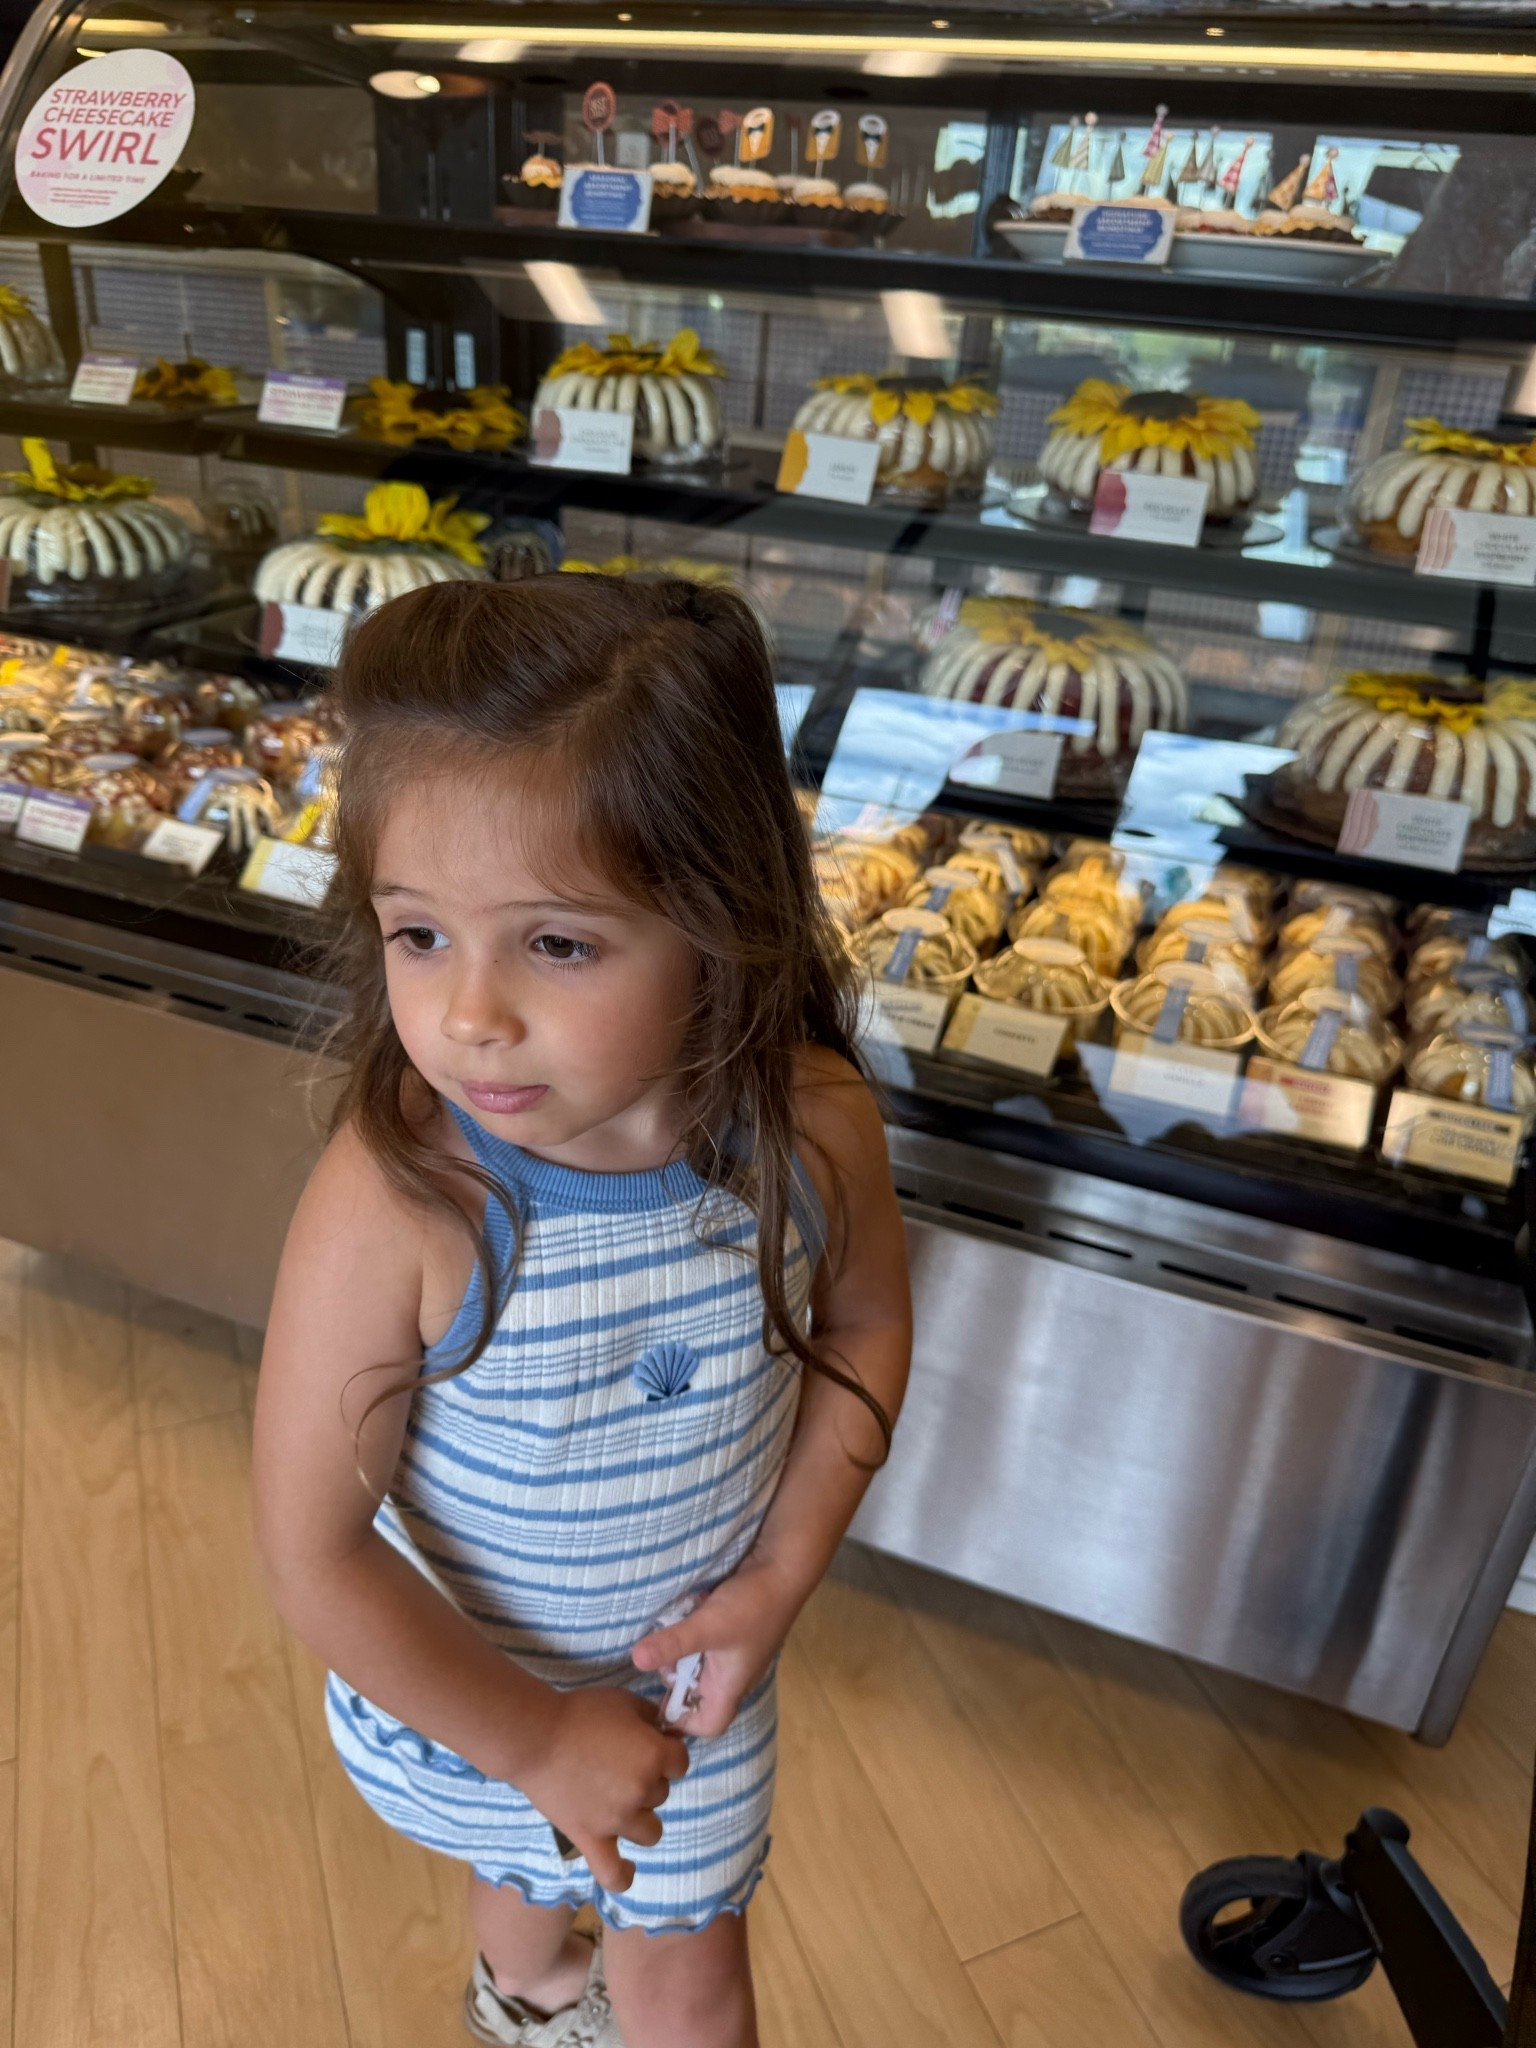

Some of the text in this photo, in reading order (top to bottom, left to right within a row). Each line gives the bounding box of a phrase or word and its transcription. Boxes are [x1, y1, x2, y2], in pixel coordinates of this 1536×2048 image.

[51, 88, 187, 109] STRAWBERRY
[44, 107, 174, 128] CHEESECAKE
[31, 127, 160, 165] SWIRL
[30, 170, 61, 179] BAKING
[63, 172, 80, 180] FOR
[89, 174, 123, 182] LIMITED
[125, 175, 146, 183] TIME
